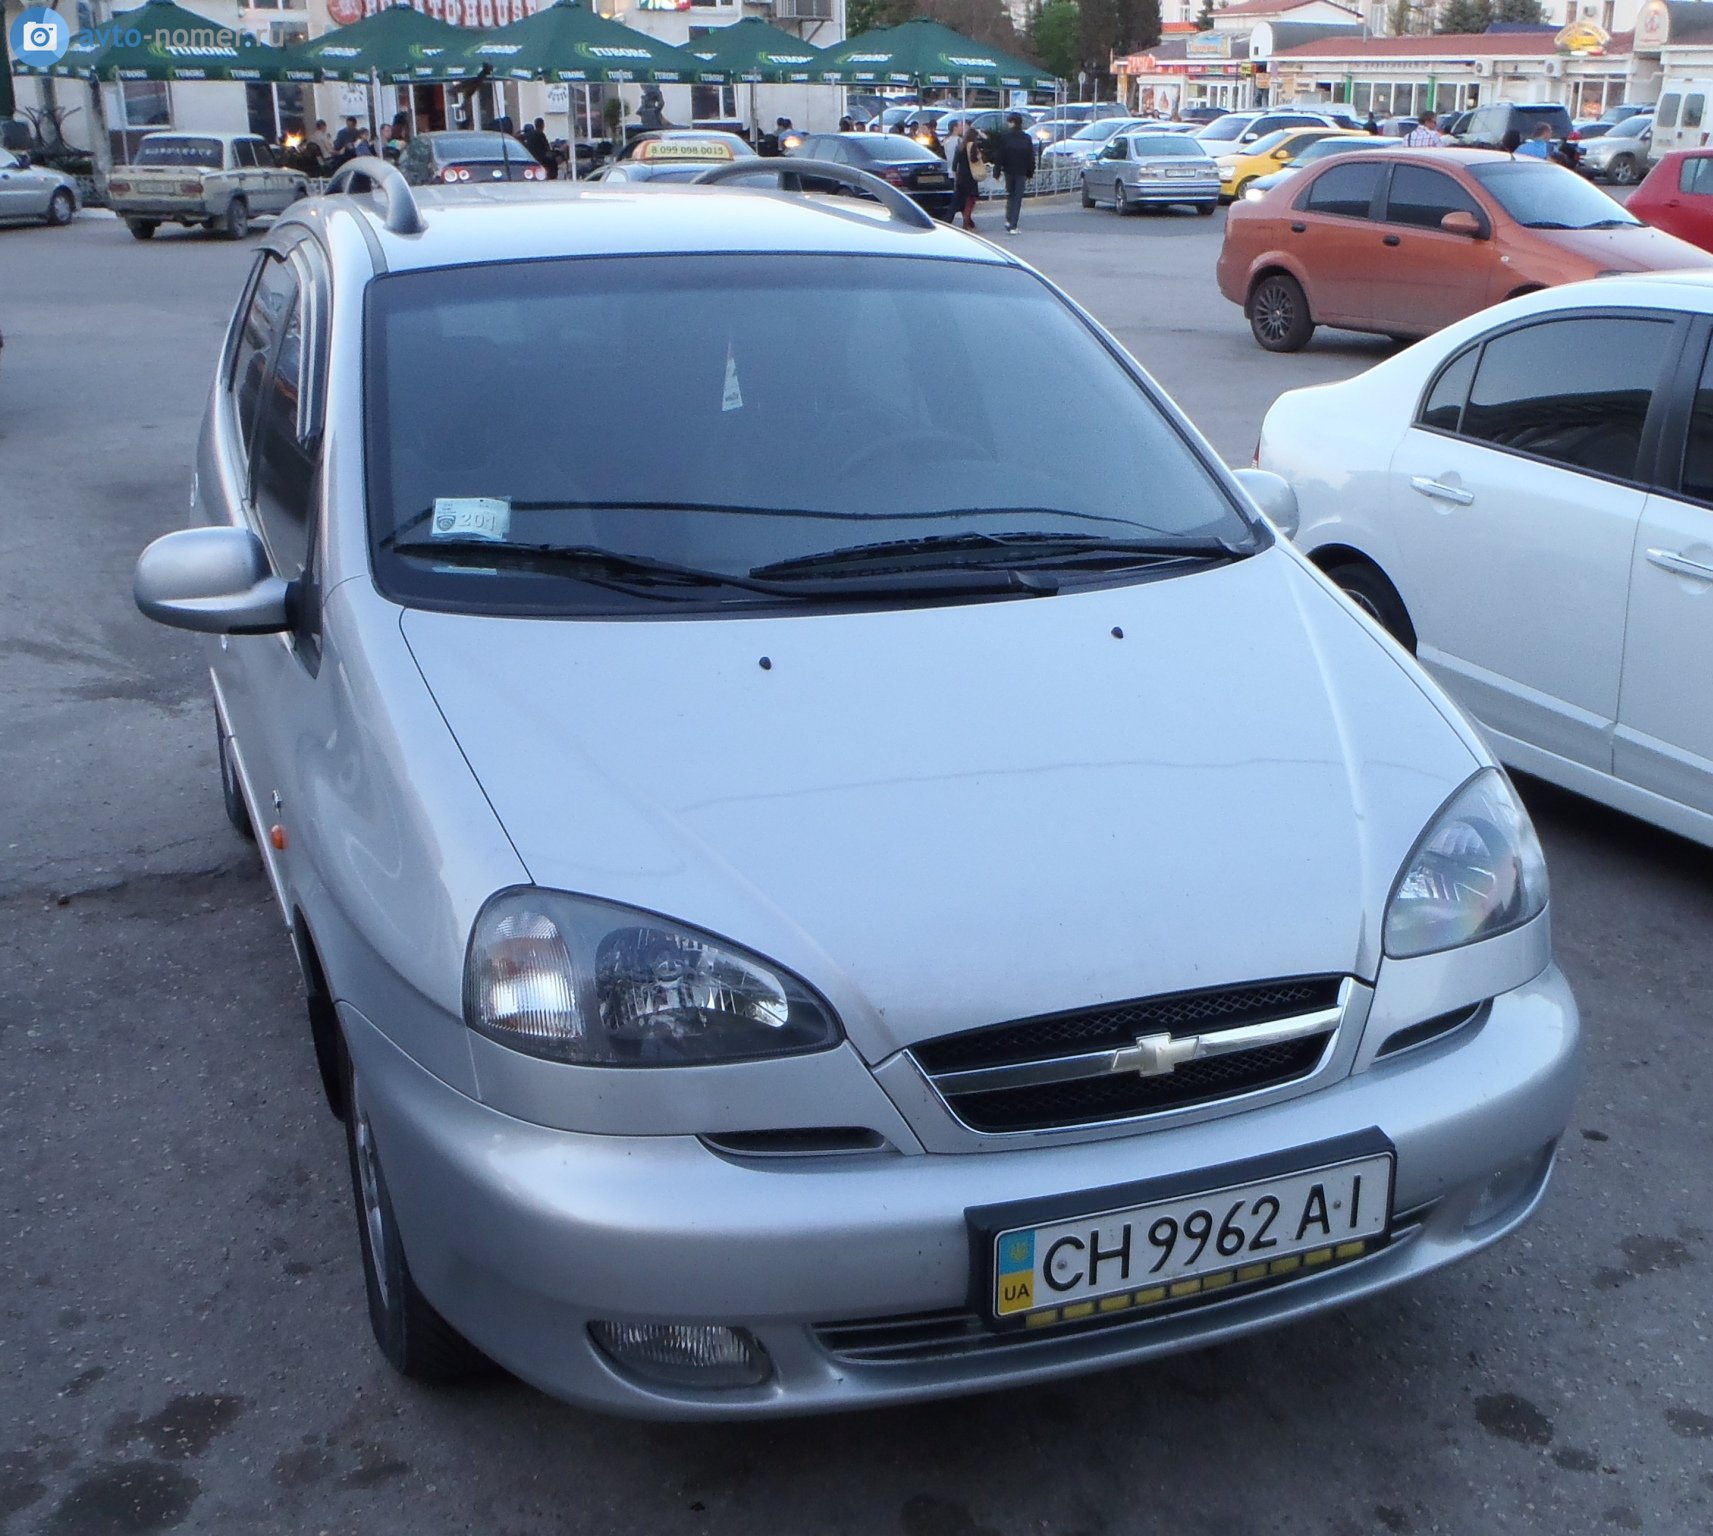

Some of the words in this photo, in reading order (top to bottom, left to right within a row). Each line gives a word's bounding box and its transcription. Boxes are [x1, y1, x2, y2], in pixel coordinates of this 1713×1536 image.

[589, 47, 652, 58] TUBORG
[660, 146, 678, 154] 099
[680, 146, 698, 154] 098
[700, 146, 724, 155] 0015
[1042, 1223, 1132, 1292] CH
[1148, 1194, 1281, 1274] 9962
[1295, 1174, 1361, 1241] AI
[1003, 1282, 1031, 1301] UA
